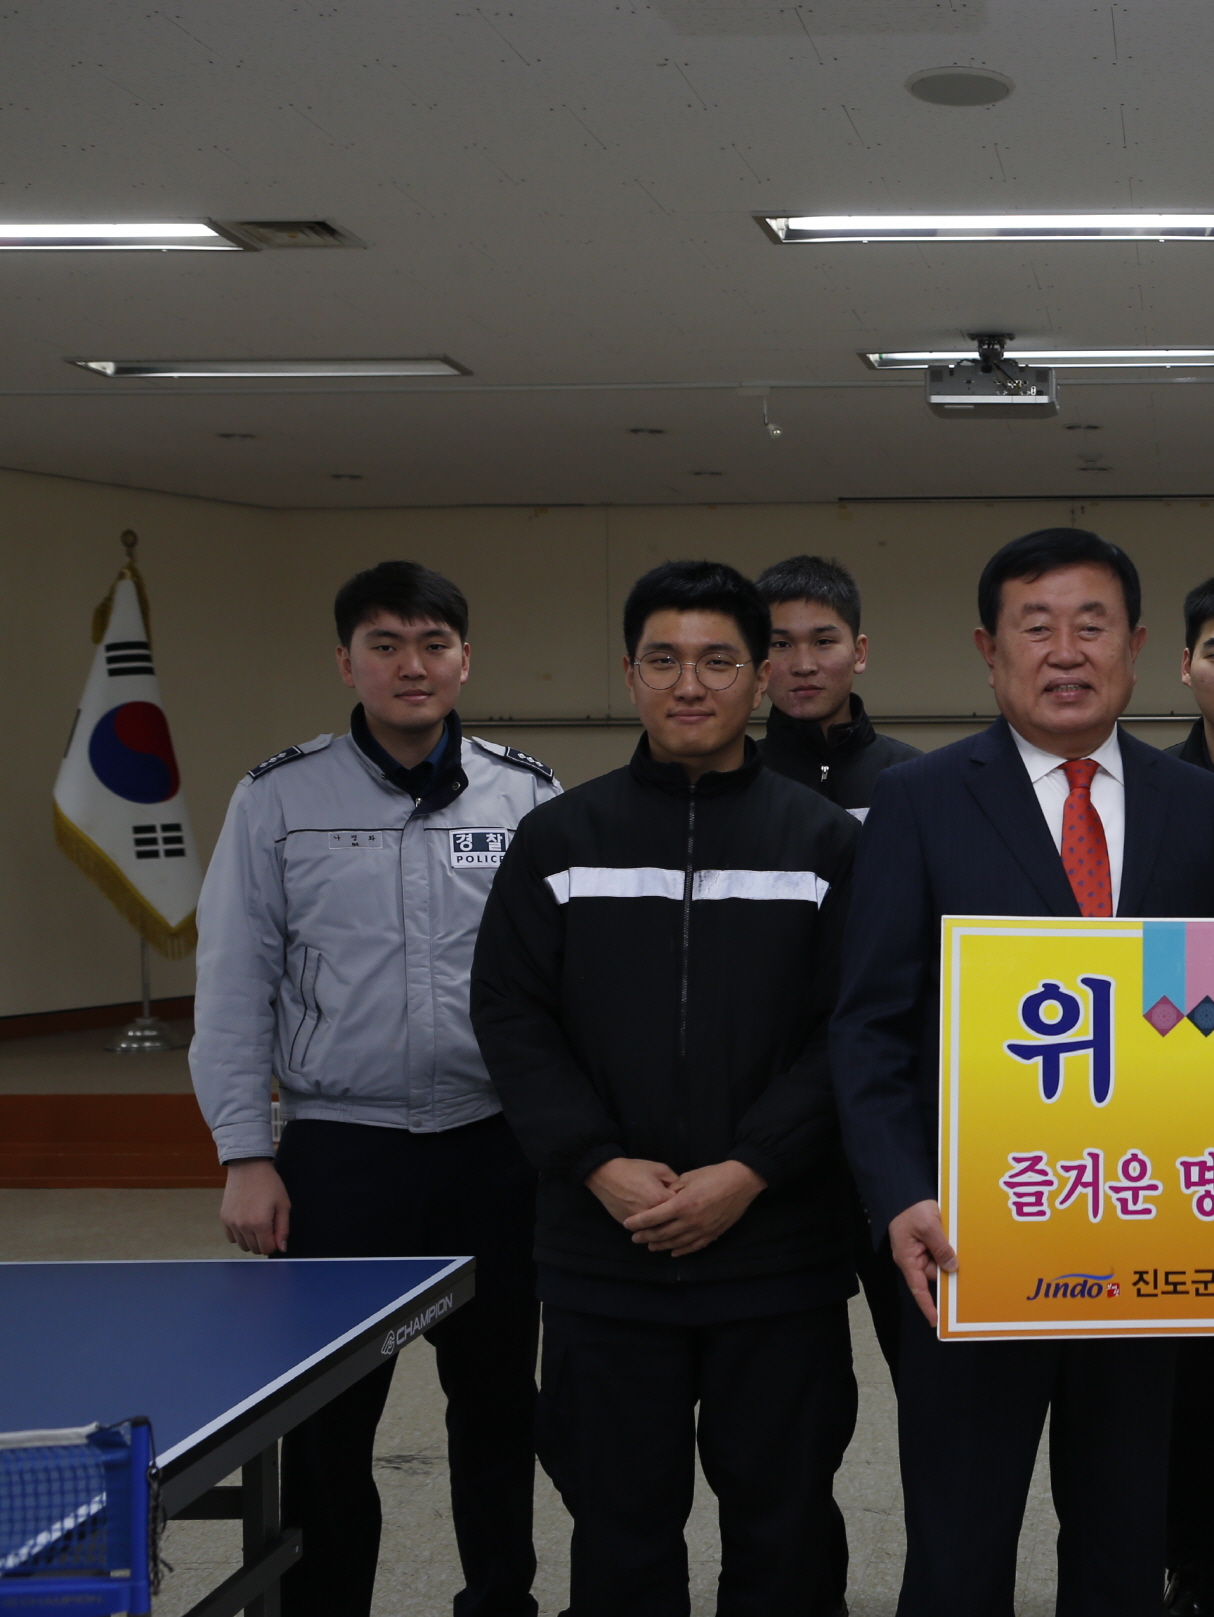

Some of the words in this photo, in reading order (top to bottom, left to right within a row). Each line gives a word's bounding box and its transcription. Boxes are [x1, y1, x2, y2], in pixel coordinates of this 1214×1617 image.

[455, 832, 504, 852] 경찰
[1005, 975, 1113, 1105] 위
[1002, 1152, 1161, 1219] 즐거운
[1026, 1278, 1104, 1301] Jindo
[396, 1292, 453, 1346] CHAMPION
